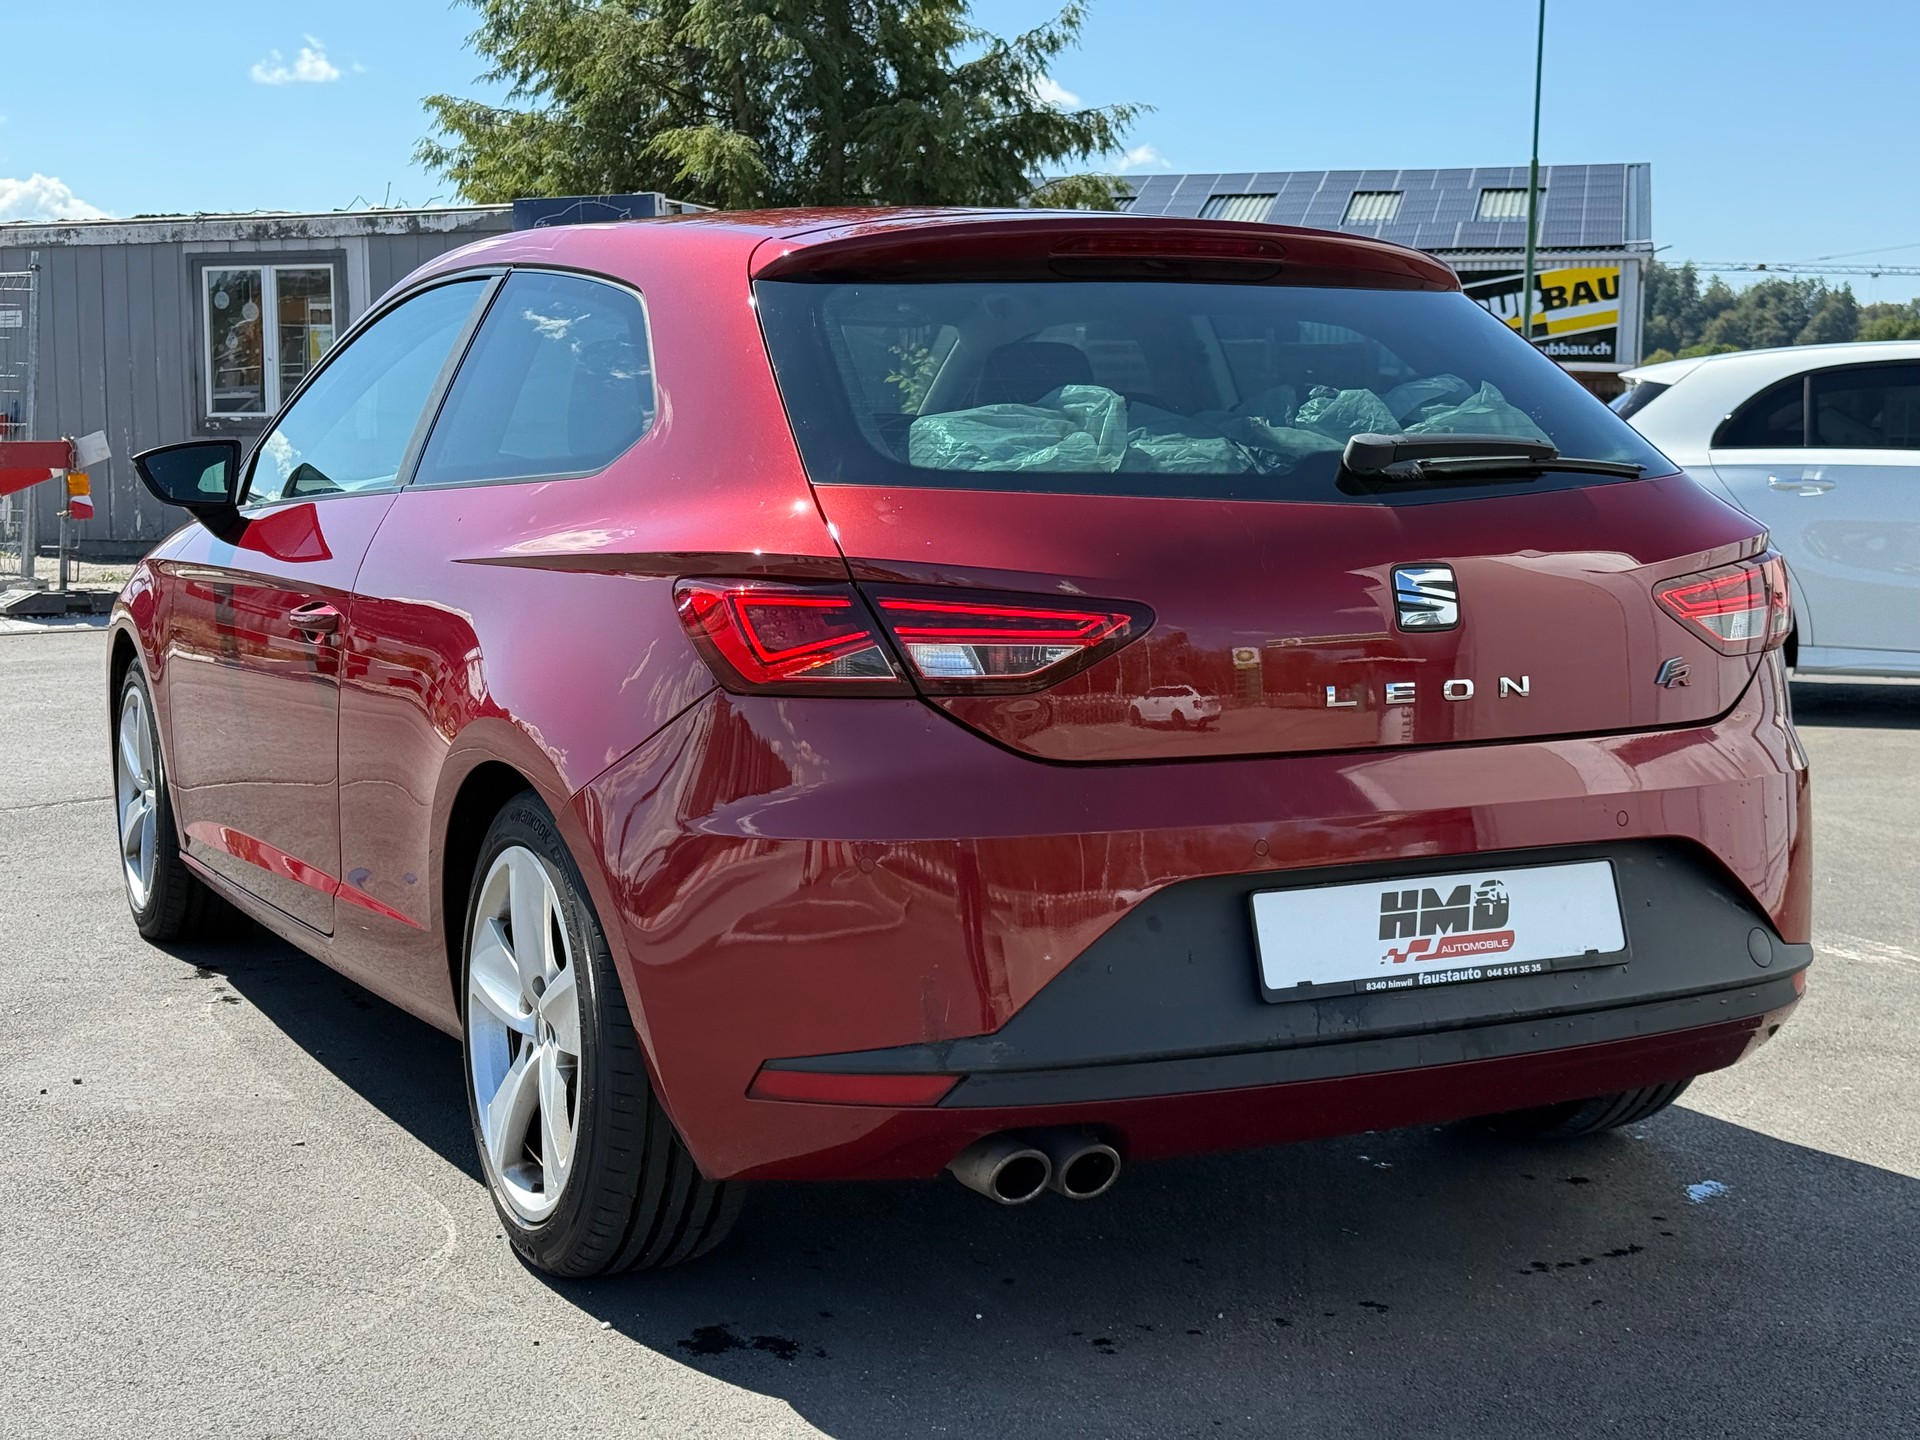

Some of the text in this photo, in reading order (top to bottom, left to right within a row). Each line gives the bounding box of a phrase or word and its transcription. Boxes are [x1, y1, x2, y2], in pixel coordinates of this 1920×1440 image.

[1326, 675, 1530, 708] LEON
[1379, 880, 1510, 940] HMD
[1441, 939, 1510, 954] AUTOMOBILE
[1366, 963, 1542, 991] 8340 hinwil faustauto 044 511 35 35
